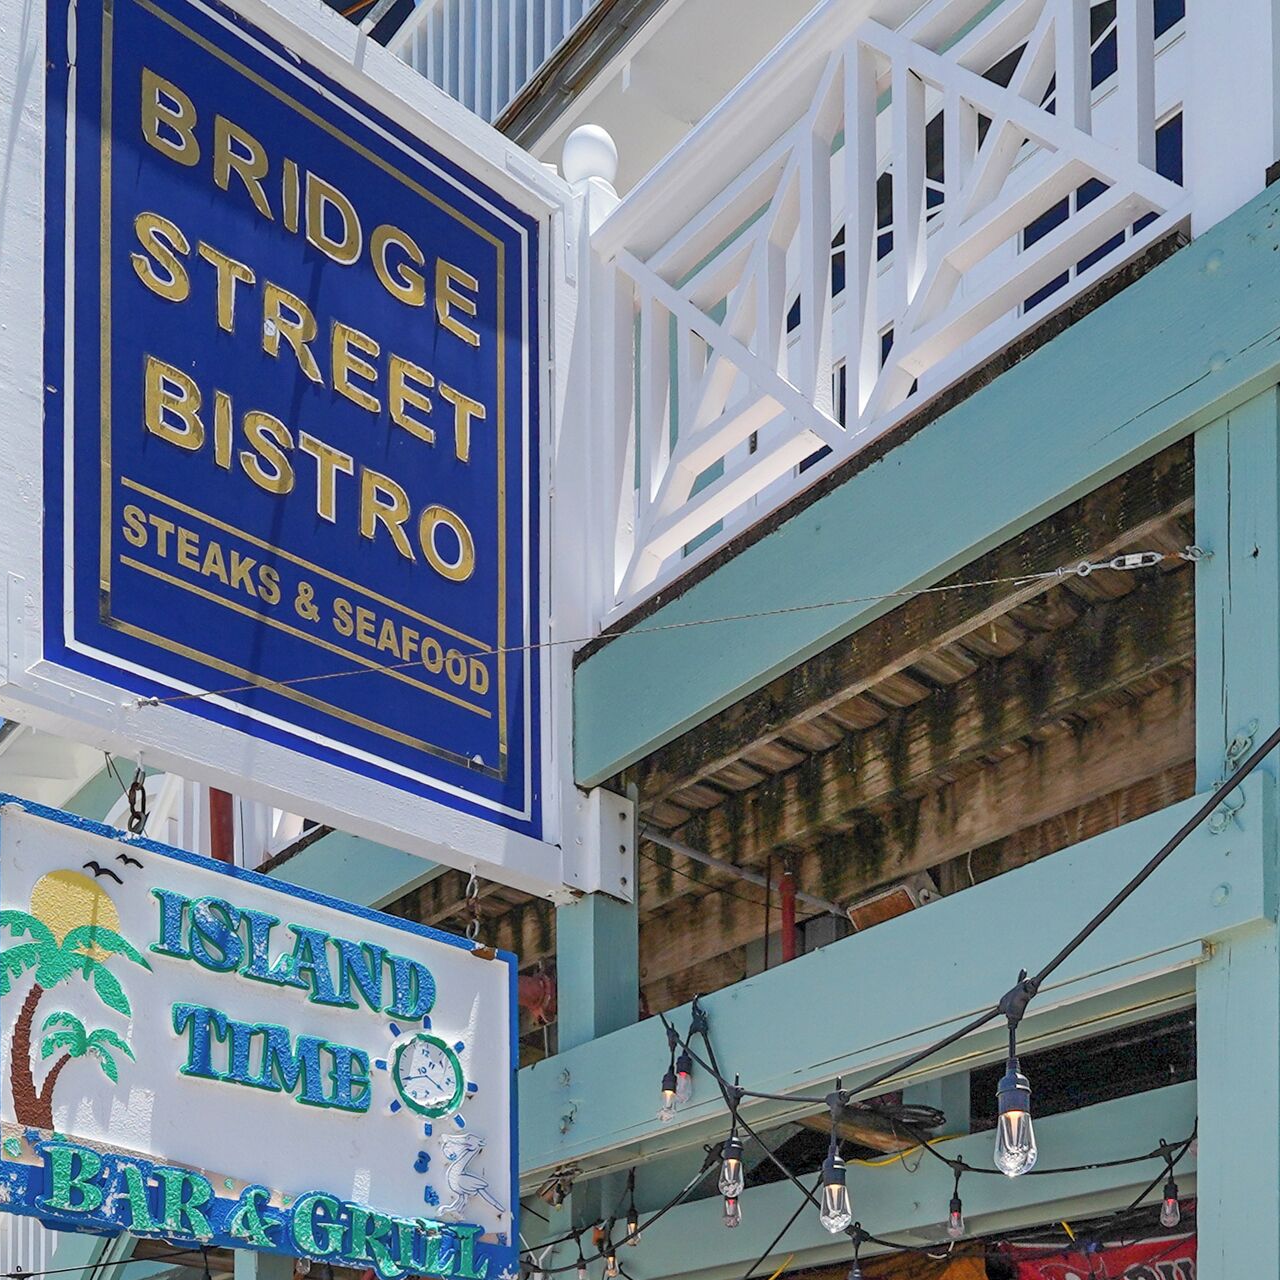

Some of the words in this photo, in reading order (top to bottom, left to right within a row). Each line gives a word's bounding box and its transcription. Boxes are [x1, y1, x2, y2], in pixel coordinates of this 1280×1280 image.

[141, 67, 481, 348] BRIDGE
[132, 211, 487, 463] STREET
[144, 355, 476, 583] BISTRO
[122, 504, 282, 606] STEAKS
[294, 583, 321, 625] &
[332, 596, 490, 697] SEAFOOD
[149, 887, 437, 1022] ISLAND
[172, 1002, 372, 1113] TIME
[39, 1142, 213, 1241] BAR
[229, 1186, 280, 1248] &
